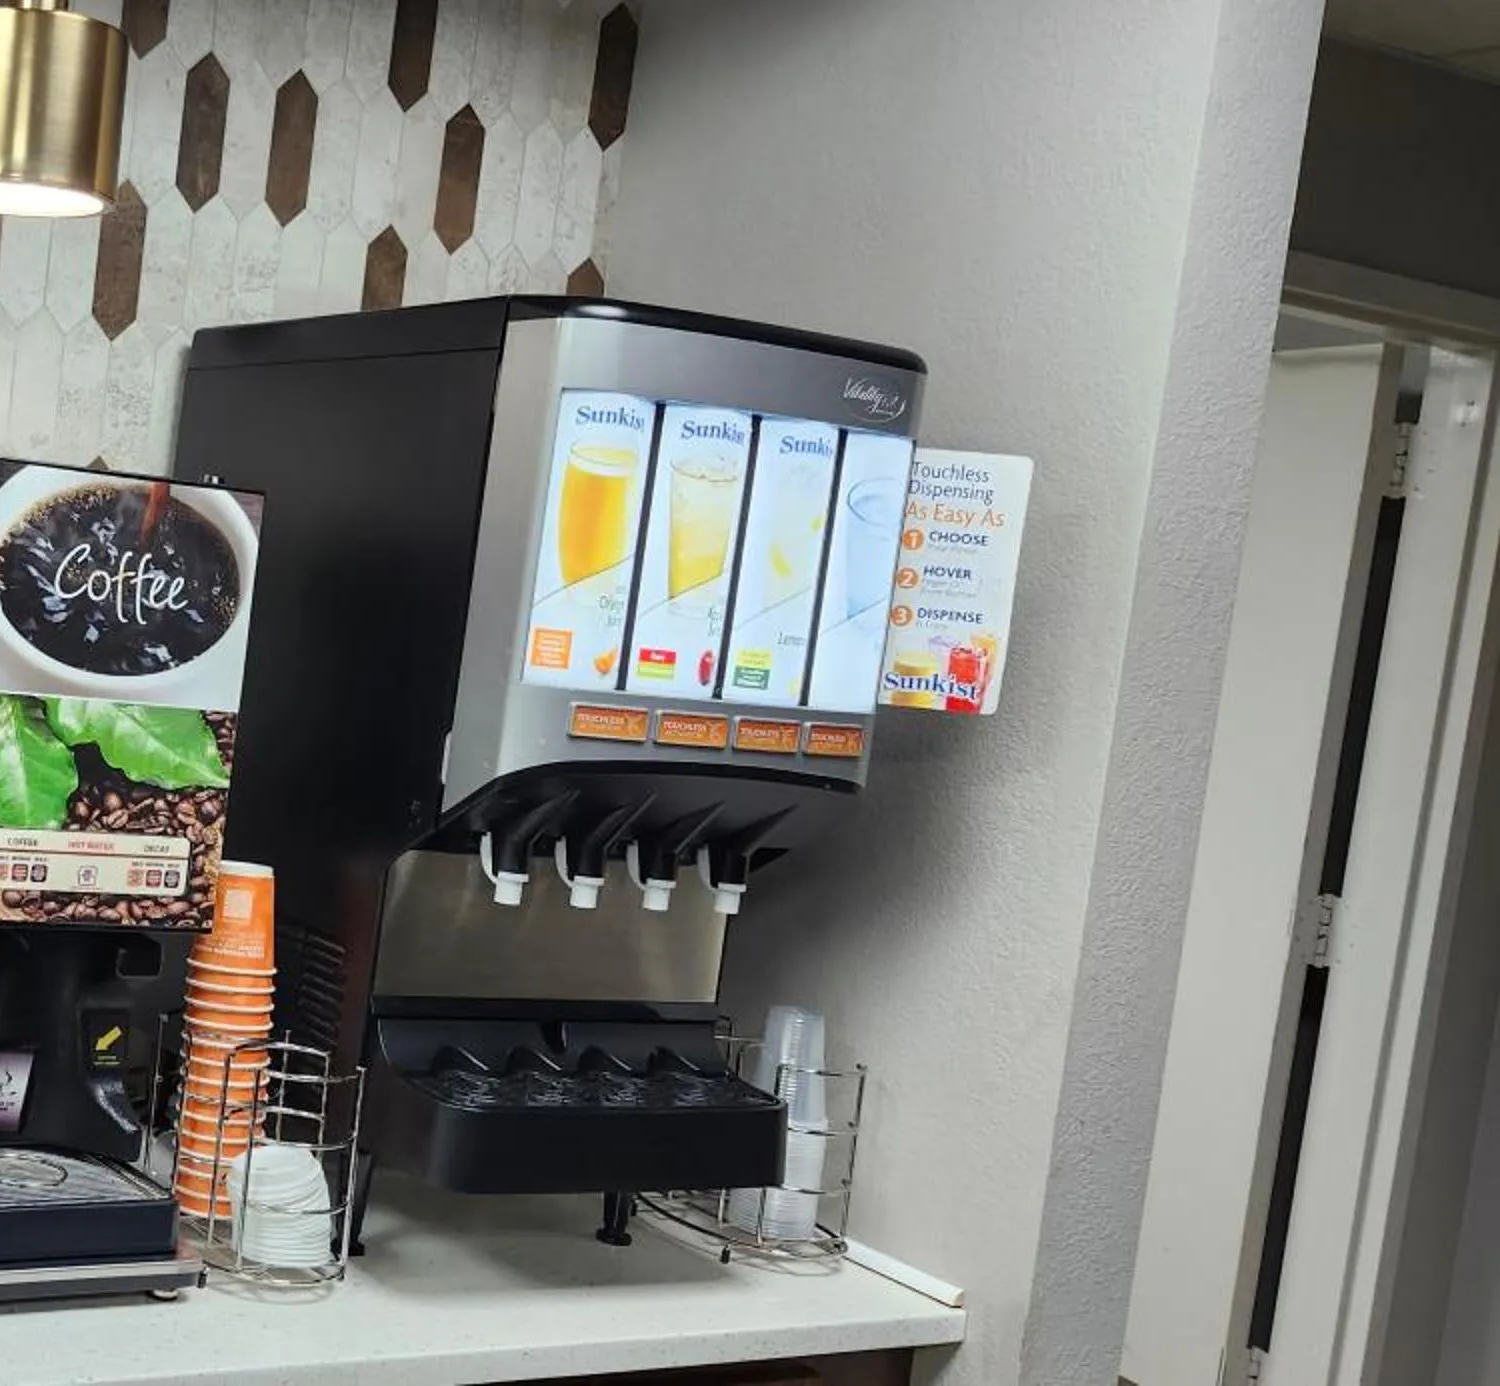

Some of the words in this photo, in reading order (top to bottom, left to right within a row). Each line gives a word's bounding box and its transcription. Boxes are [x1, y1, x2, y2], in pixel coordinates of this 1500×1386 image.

[911, 461, 991, 483] Touchless
[907, 480, 995, 507] Dispensing
[906, 502, 927, 521] As
[933, 503, 977, 528] Easy
[980, 509, 1006, 528] As
[929, 530, 989, 547] CHOOSE
[54, 543, 189, 625] Coffee
[923, 565, 972, 580] HOVER
[917, 607, 984, 624] DISPENSE
[883, 671, 978, 700] Sunkist
